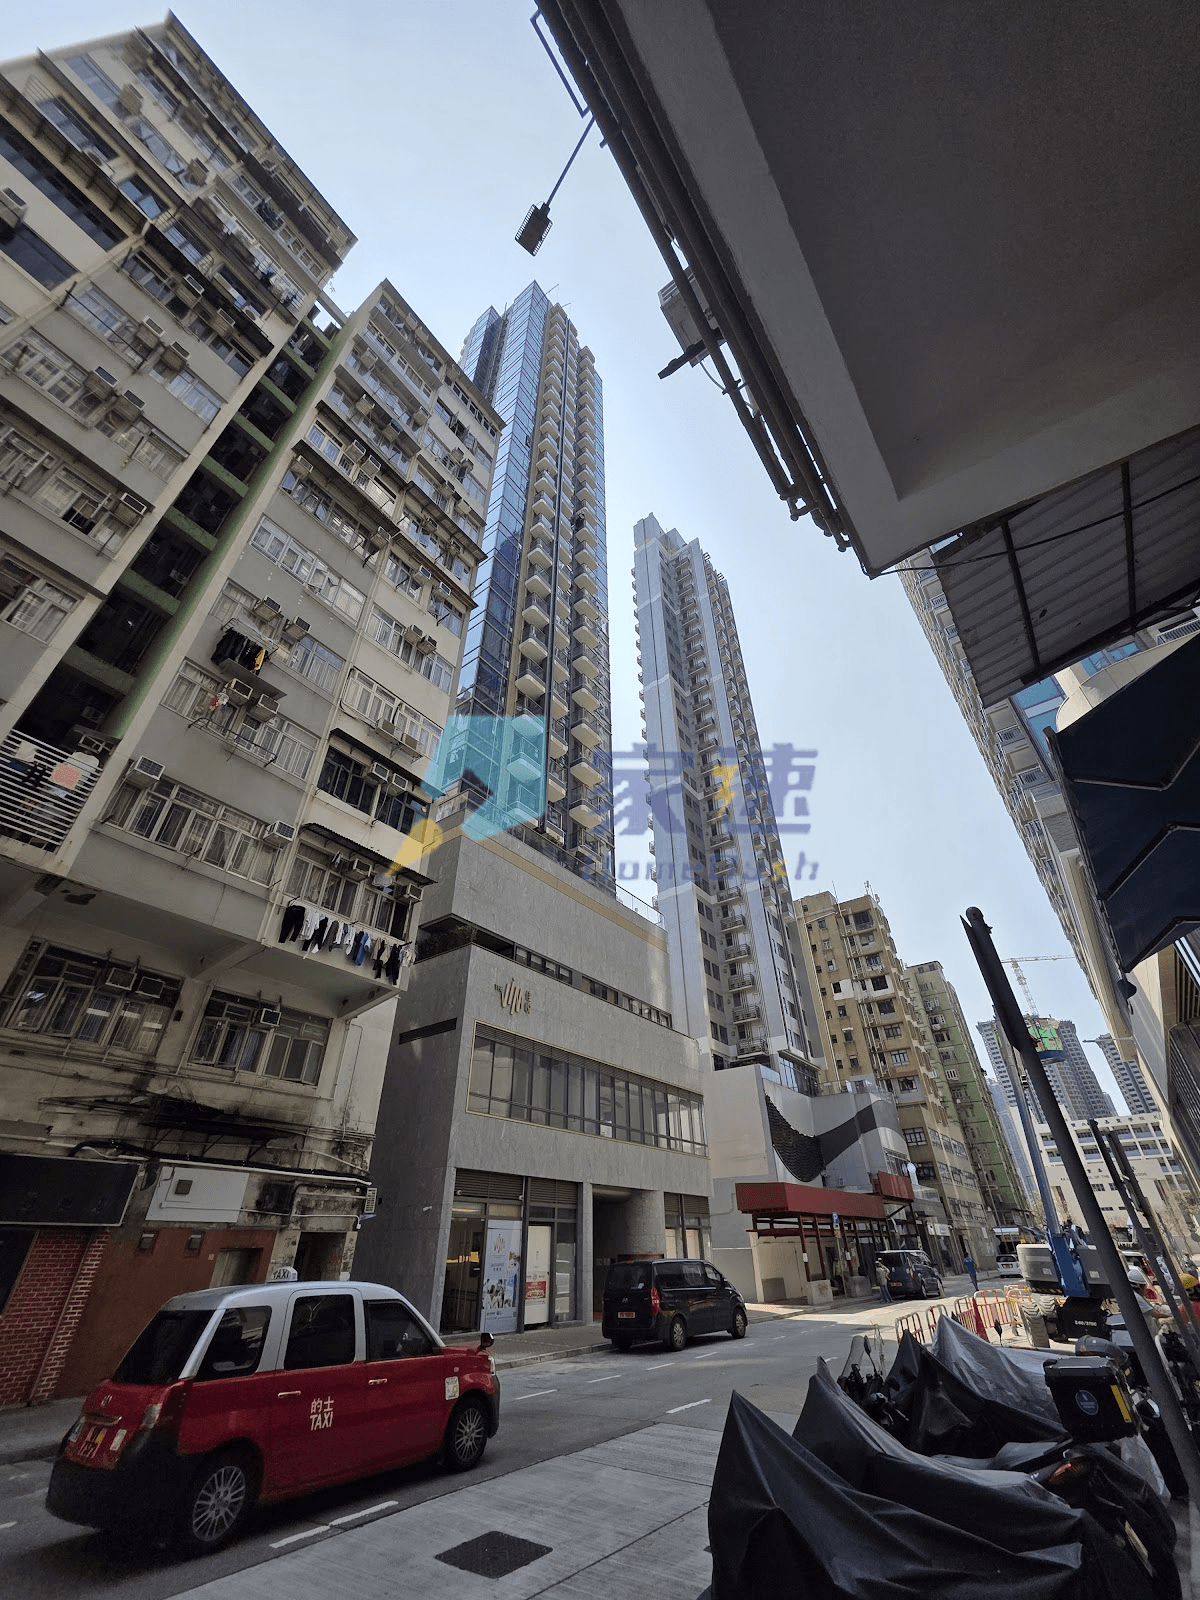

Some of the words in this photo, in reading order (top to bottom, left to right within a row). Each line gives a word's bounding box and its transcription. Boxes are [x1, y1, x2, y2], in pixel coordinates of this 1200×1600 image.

[273, 1268, 290, 1280] TAXI
[310, 1395, 335, 1414] 的士
[309, 1411, 334, 1431] TAXI
